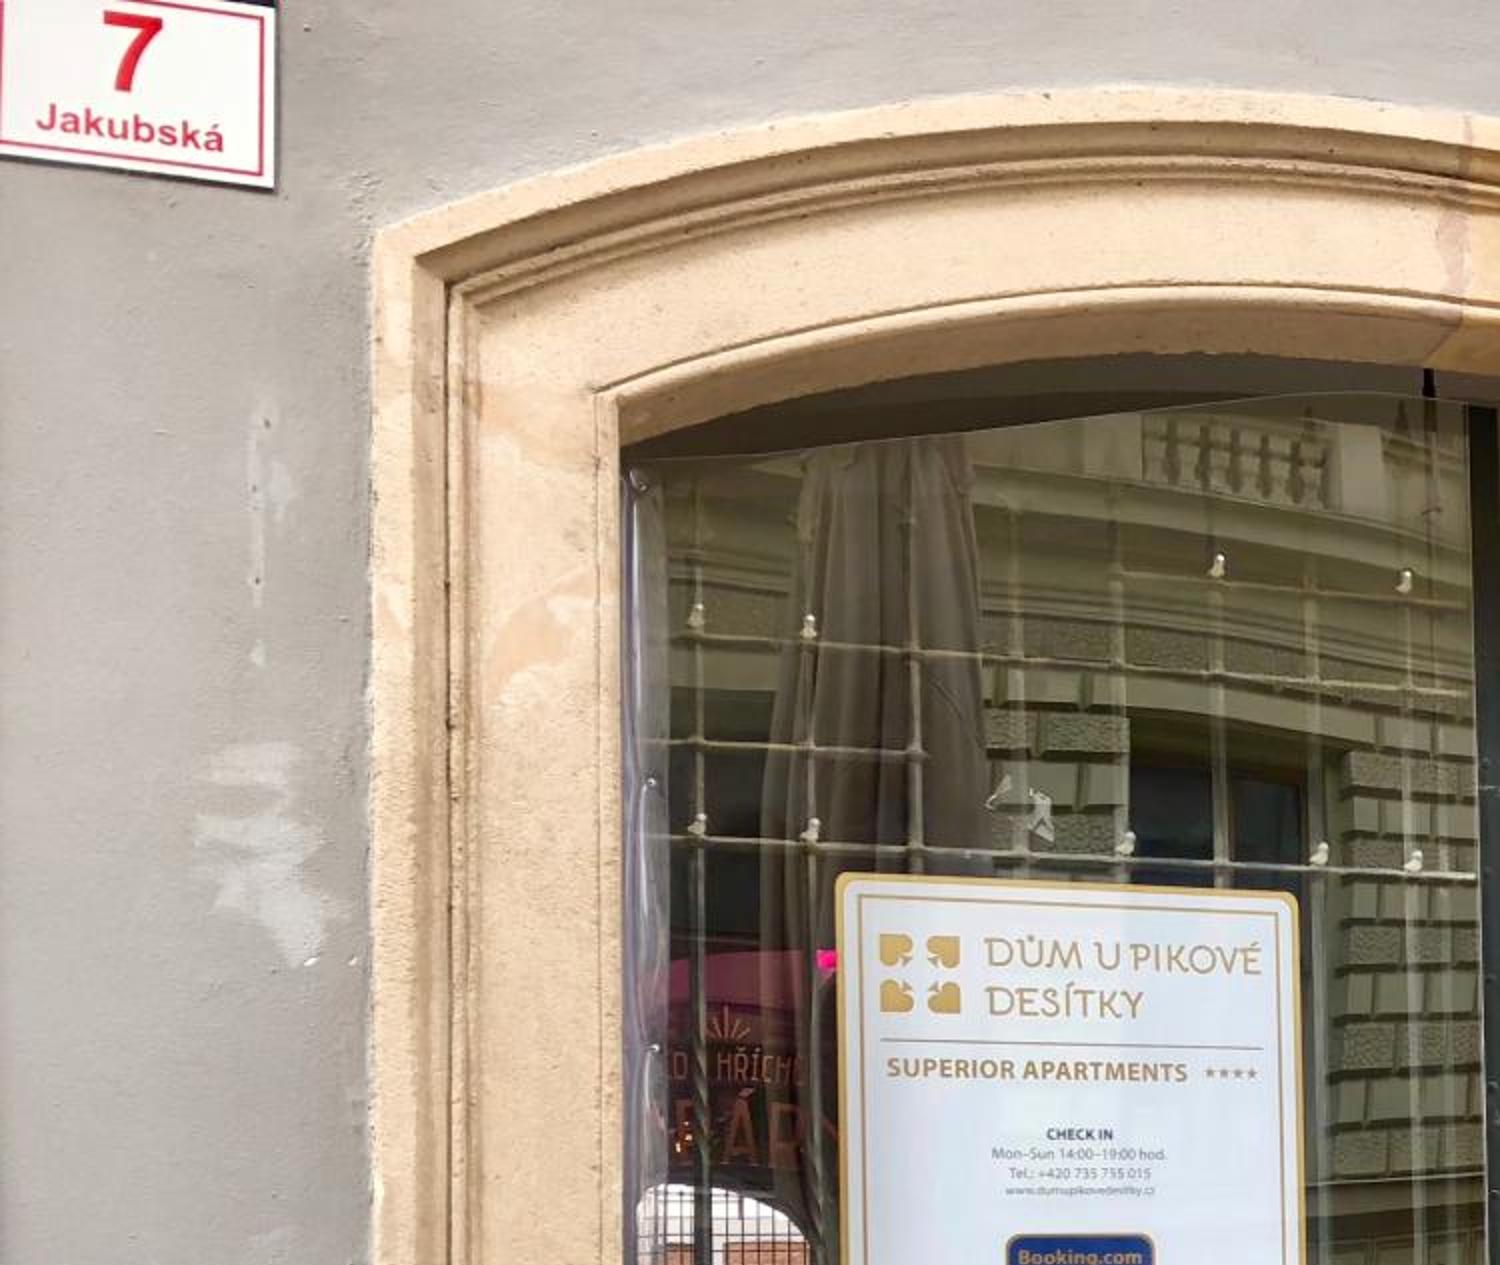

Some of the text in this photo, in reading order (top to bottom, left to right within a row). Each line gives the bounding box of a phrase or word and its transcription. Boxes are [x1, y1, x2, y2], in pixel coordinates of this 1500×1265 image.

[103, 10, 163, 93] 7
[36, 103, 224, 152] Jakubská
[984, 934, 1263, 976] DŮM U PIKOVÉ
[984, 982, 1145, 1019] DESÍTKY
[886, 1057, 1188, 1083] SUPERIOR APARTMENTS
[1046, 1127, 1113, 1141] CHECK IN
[1039, 1167, 1071, 1180] +420
